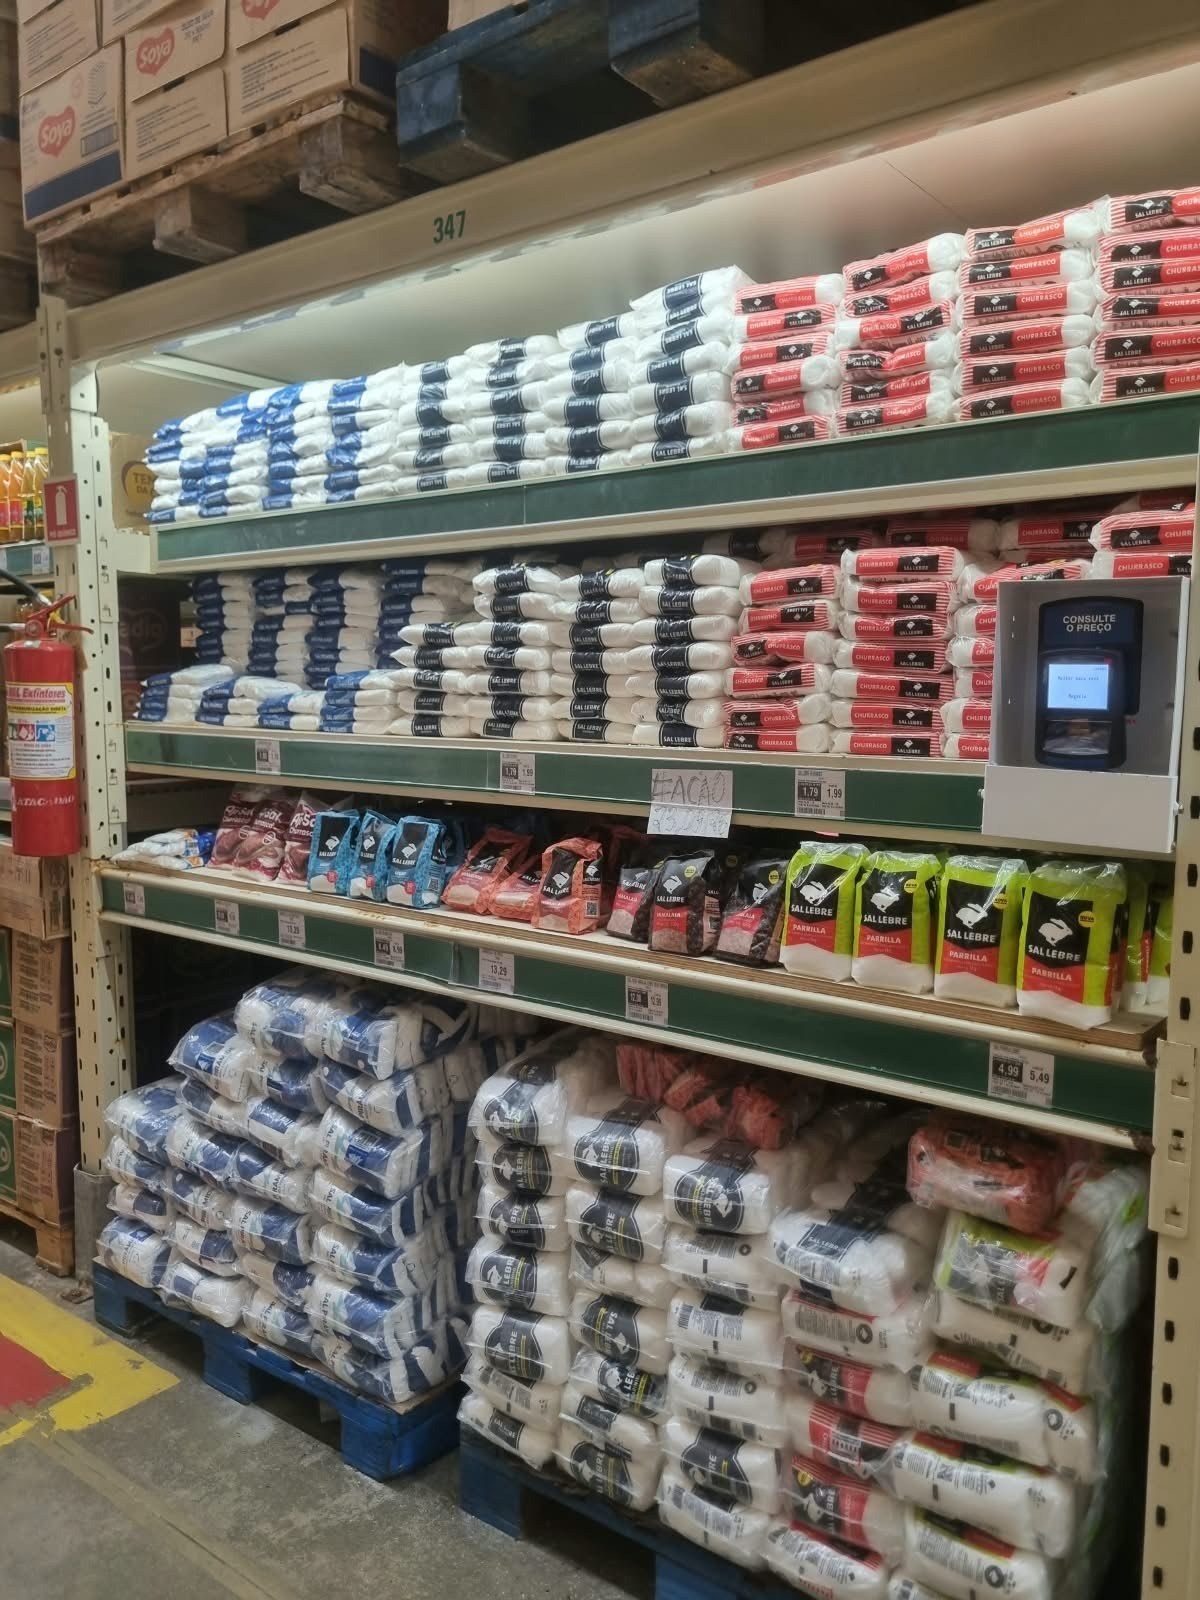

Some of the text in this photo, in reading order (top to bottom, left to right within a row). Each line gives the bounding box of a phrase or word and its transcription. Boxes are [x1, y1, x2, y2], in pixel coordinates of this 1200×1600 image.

[41, 118, 73, 147] Soya
[433, 211, 466, 244] 347
[1021, 292, 1062, 304] CHURRASCO
[1016, 330, 1057, 342] CHURRASCO
[1019, 363, 1060, 374] CHURRASCO
[1016, 396, 1056, 406] CHURRASCO
[1118, 562, 1164, 572] CHURRASCO
[860, 596, 893, 605] CHURRASCO
[1062, 614, 1116, 624] CONSULTE
[1066, 623, 1112, 634] O PREÇO
[856, 654, 890, 662] CHURRASCO
[854, 712, 889, 720] CHURRASCO
[802, 786, 843, 799] 1,79 1,99
[542, 884, 555, 894] SAL
[792, 904, 833, 916] SAL LEBRE
[864, 914, 908, 926] SAL LEBRE
[792, 924, 826, 934] PARRILLA
[866, 934, 901, 944] PARRILLA
[947, 928, 996, 943] SAL LEBRE
[950, 950, 988, 962] PARRILLA
[1028, 944, 1081, 962] SAL LEBRE
[490, 964, 508, 976] 13,29
[1032, 967, 1072, 982] PARRILLA
[998, 1063, 1050, 1084] 4,99 5,49
